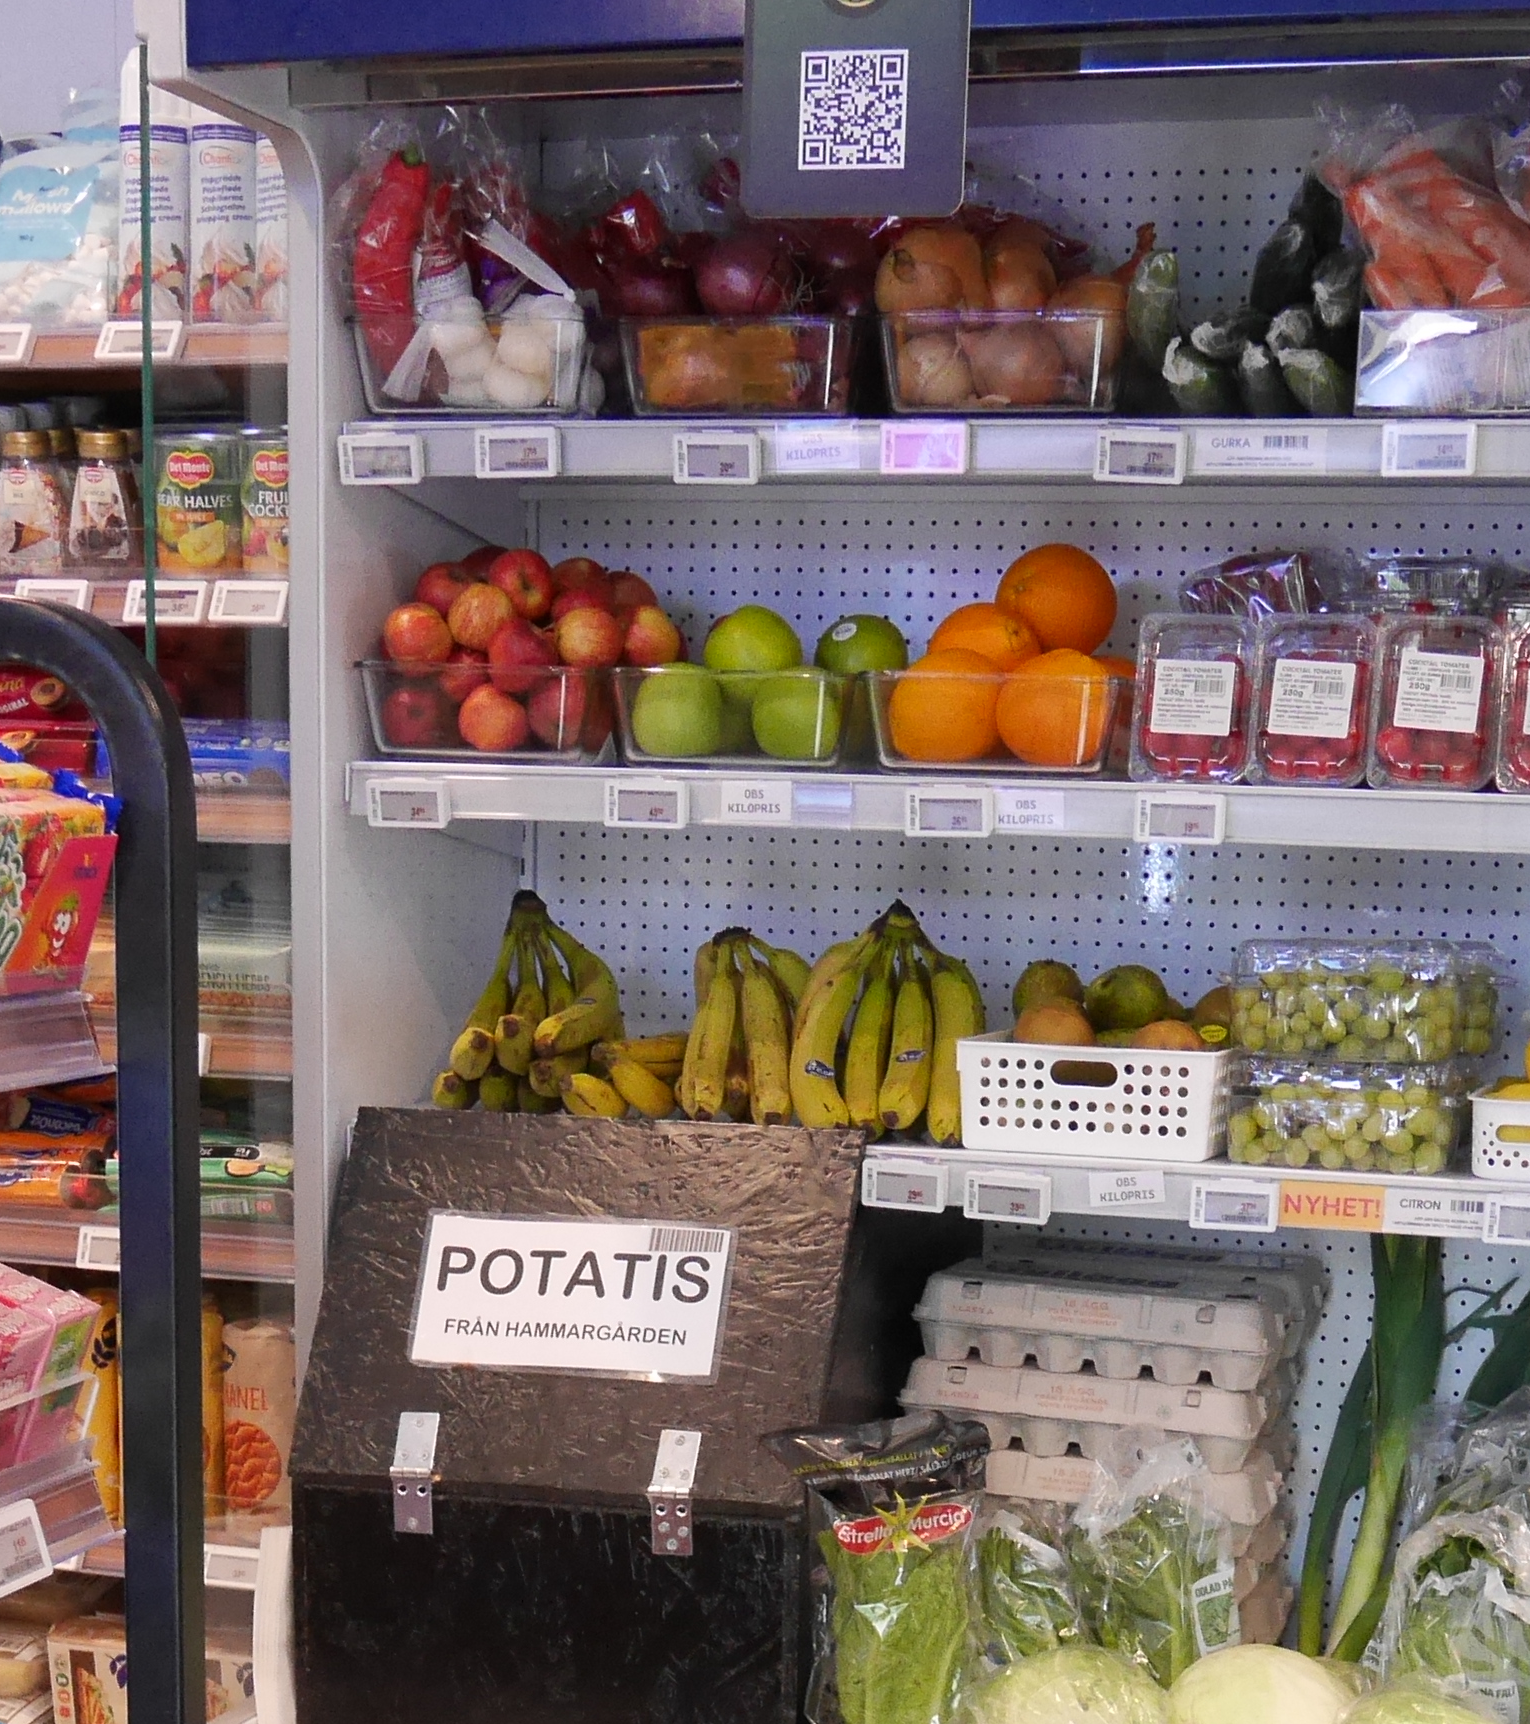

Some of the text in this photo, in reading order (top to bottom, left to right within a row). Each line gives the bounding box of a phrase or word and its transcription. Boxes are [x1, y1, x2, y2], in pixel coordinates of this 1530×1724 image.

[1211, 437, 1251, 449] GURKA
[785, 446, 842, 460] KILOPRIS
[185, 494, 233, 508] HALVES
[745, 789, 765, 800] OBS
[727, 802, 781, 815] KILOPRIS
[1015, 799, 1037, 811] OBS
[998, 811, 1054, 825] KILOPRIS
[1115, 1177, 1138, 1189] OBS
[1099, 1189, 1157, 1202] KILOPRIS
[1284, 1194, 1382, 1220] NYHET!
[1398, 1198, 1441, 1211] CITRON
[437, 1245, 710, 1303] POTATIS
[444, 1317, 687, 1346] FRÅN HAMMARGÅRDEN
